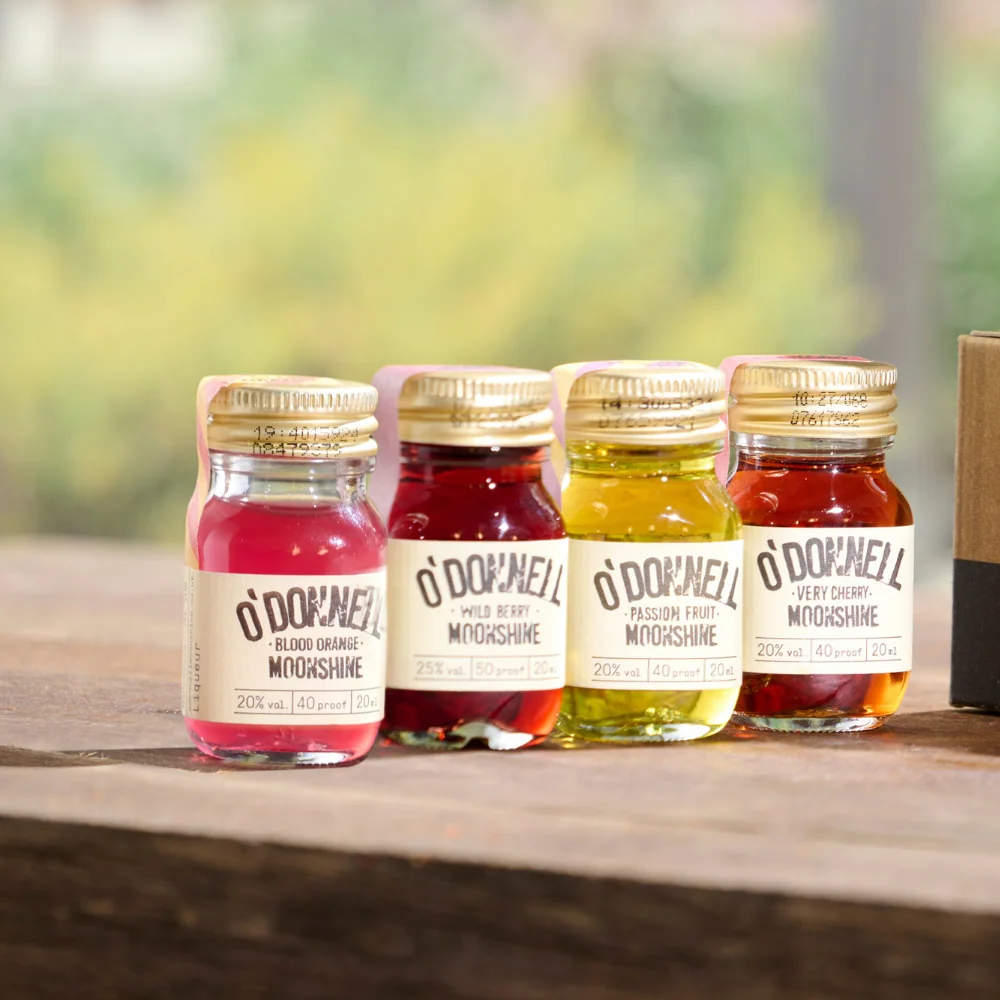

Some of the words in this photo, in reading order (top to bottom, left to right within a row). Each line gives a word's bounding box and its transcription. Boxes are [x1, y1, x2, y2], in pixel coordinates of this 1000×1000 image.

[757, 535, 905, 591] O'DONNELL
[416, 552, 563, 608] O'DONNELL
[593, 555, 739, 611] O'DONNELL
[797, 585, 828, 601] VERY
[831, 585, 870, 600] CHERRY
[236, 585, 383, 642] O'DONNELL
[460, 605, 491, 619] WILD
[497, 605, 530, 619] BERRY
[630, 606, 680, 621] PASSION
[685, 606, 716, 620] FRUIT
[788, 604, 880, 628] MOONSHINE
[275, 637, 313, 651] BLOOD
[316, 636, 359, 651] ORANGE
[448, 622, 541, 646] MOONSHINE
[625, 624, 718, 647] MOONSHINE
[757, 642, 784, 657] 20%
[268, 655, 364, 680] MOONSHINE
[416, 661, 443, 675] 25%
[594, 662, 621, 677] 20%
[236, 694, 265, 710] 20%
[267, 700, 289, 710] vol.
